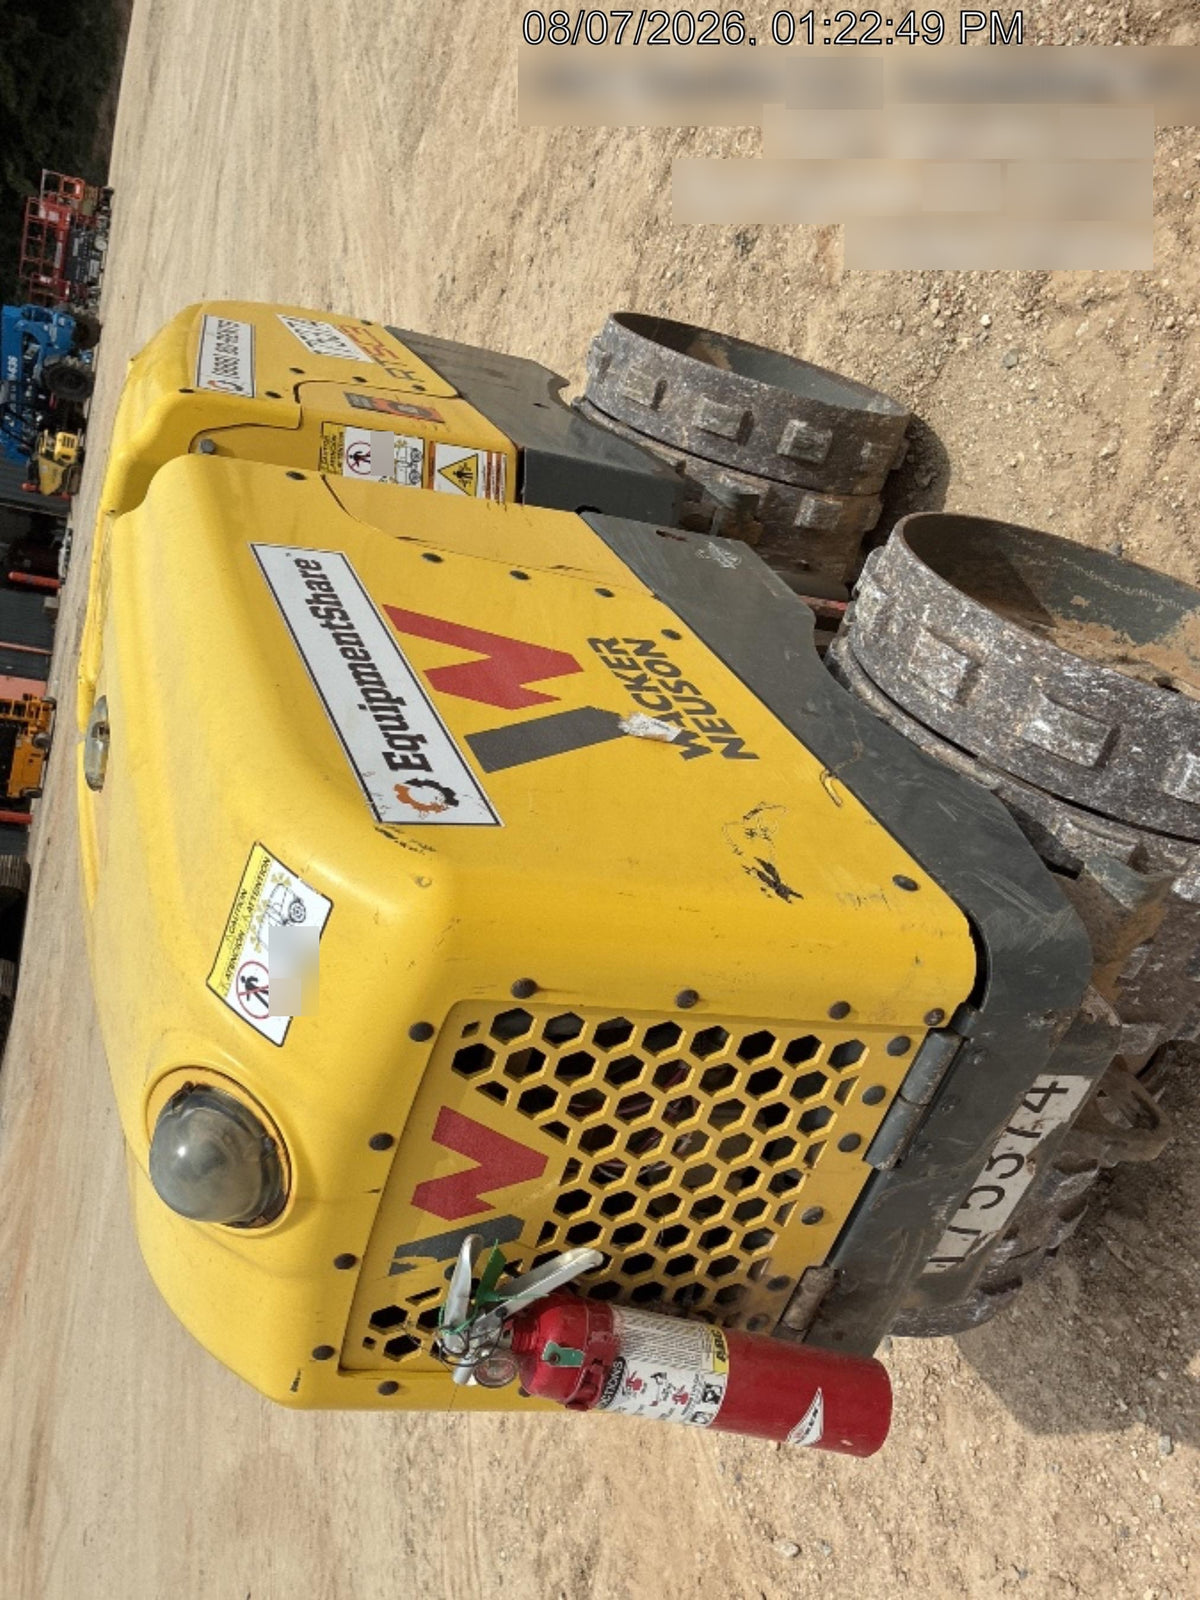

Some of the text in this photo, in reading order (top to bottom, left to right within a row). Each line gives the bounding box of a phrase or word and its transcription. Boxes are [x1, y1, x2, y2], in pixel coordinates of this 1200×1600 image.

[292, 557, 435, 773] EquipmentShare
[622, 637, 761, 760] NEUSON
[229, 888, 248, 934] CAUTION
[246, 856, 272, 914] ATTENTION
